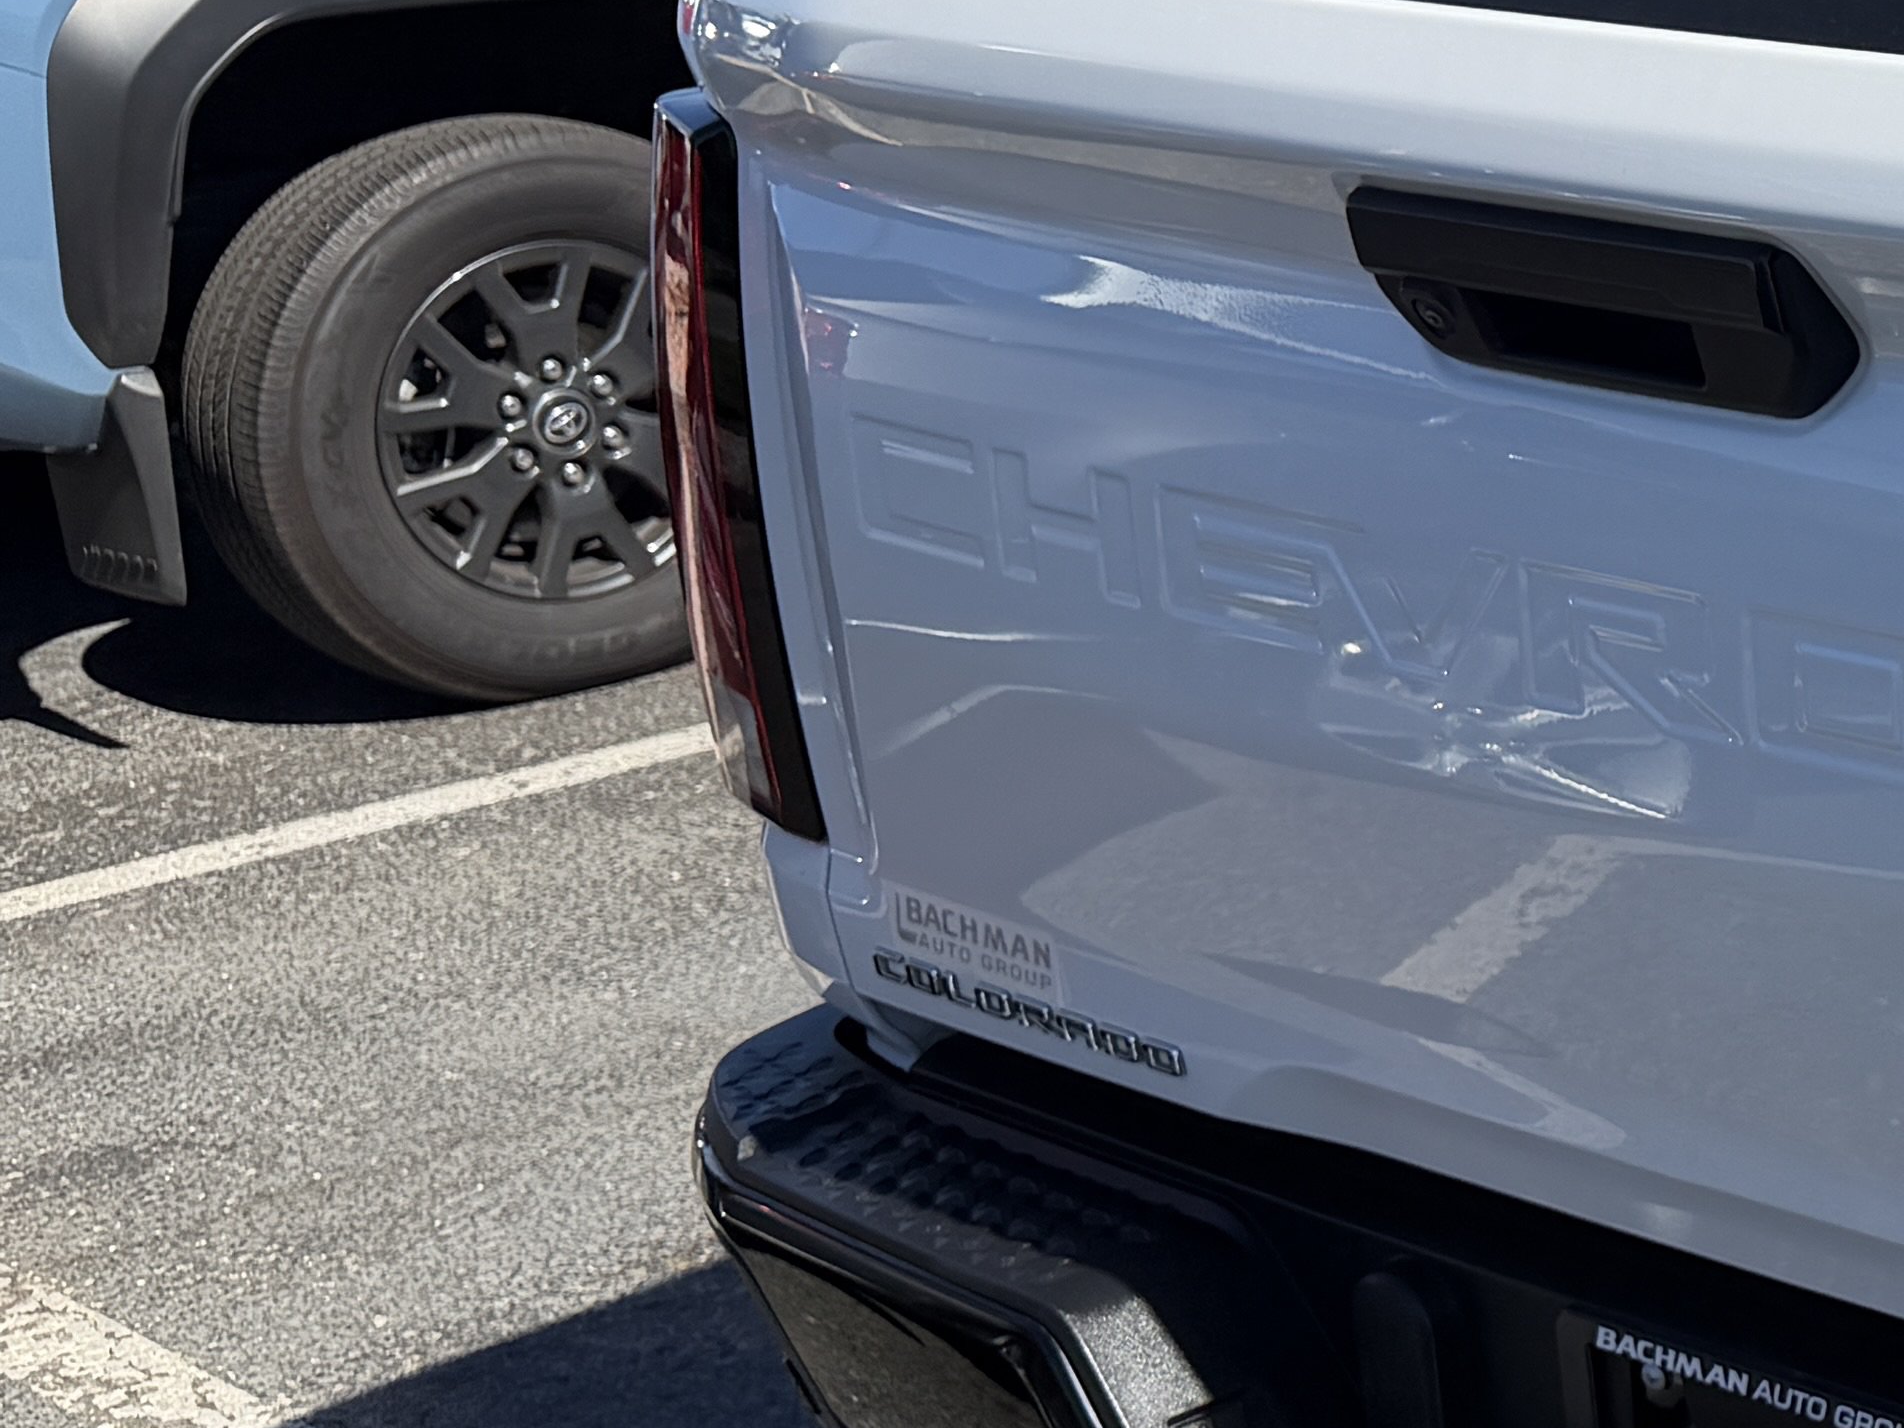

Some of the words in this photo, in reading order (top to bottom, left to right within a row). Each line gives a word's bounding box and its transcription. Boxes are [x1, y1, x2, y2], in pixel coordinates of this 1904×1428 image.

[904, 895, 1051, 969] BACHMAN
[917, 930, 971, 965] AUTO
[980, 952, 1052, 991] GROUP
[873, 945, 1188, 1076] COLORADO
[1595, 1324, 1748, 1397] BACHMAN
[1751, 1379, 1827, 1422] AUTO
